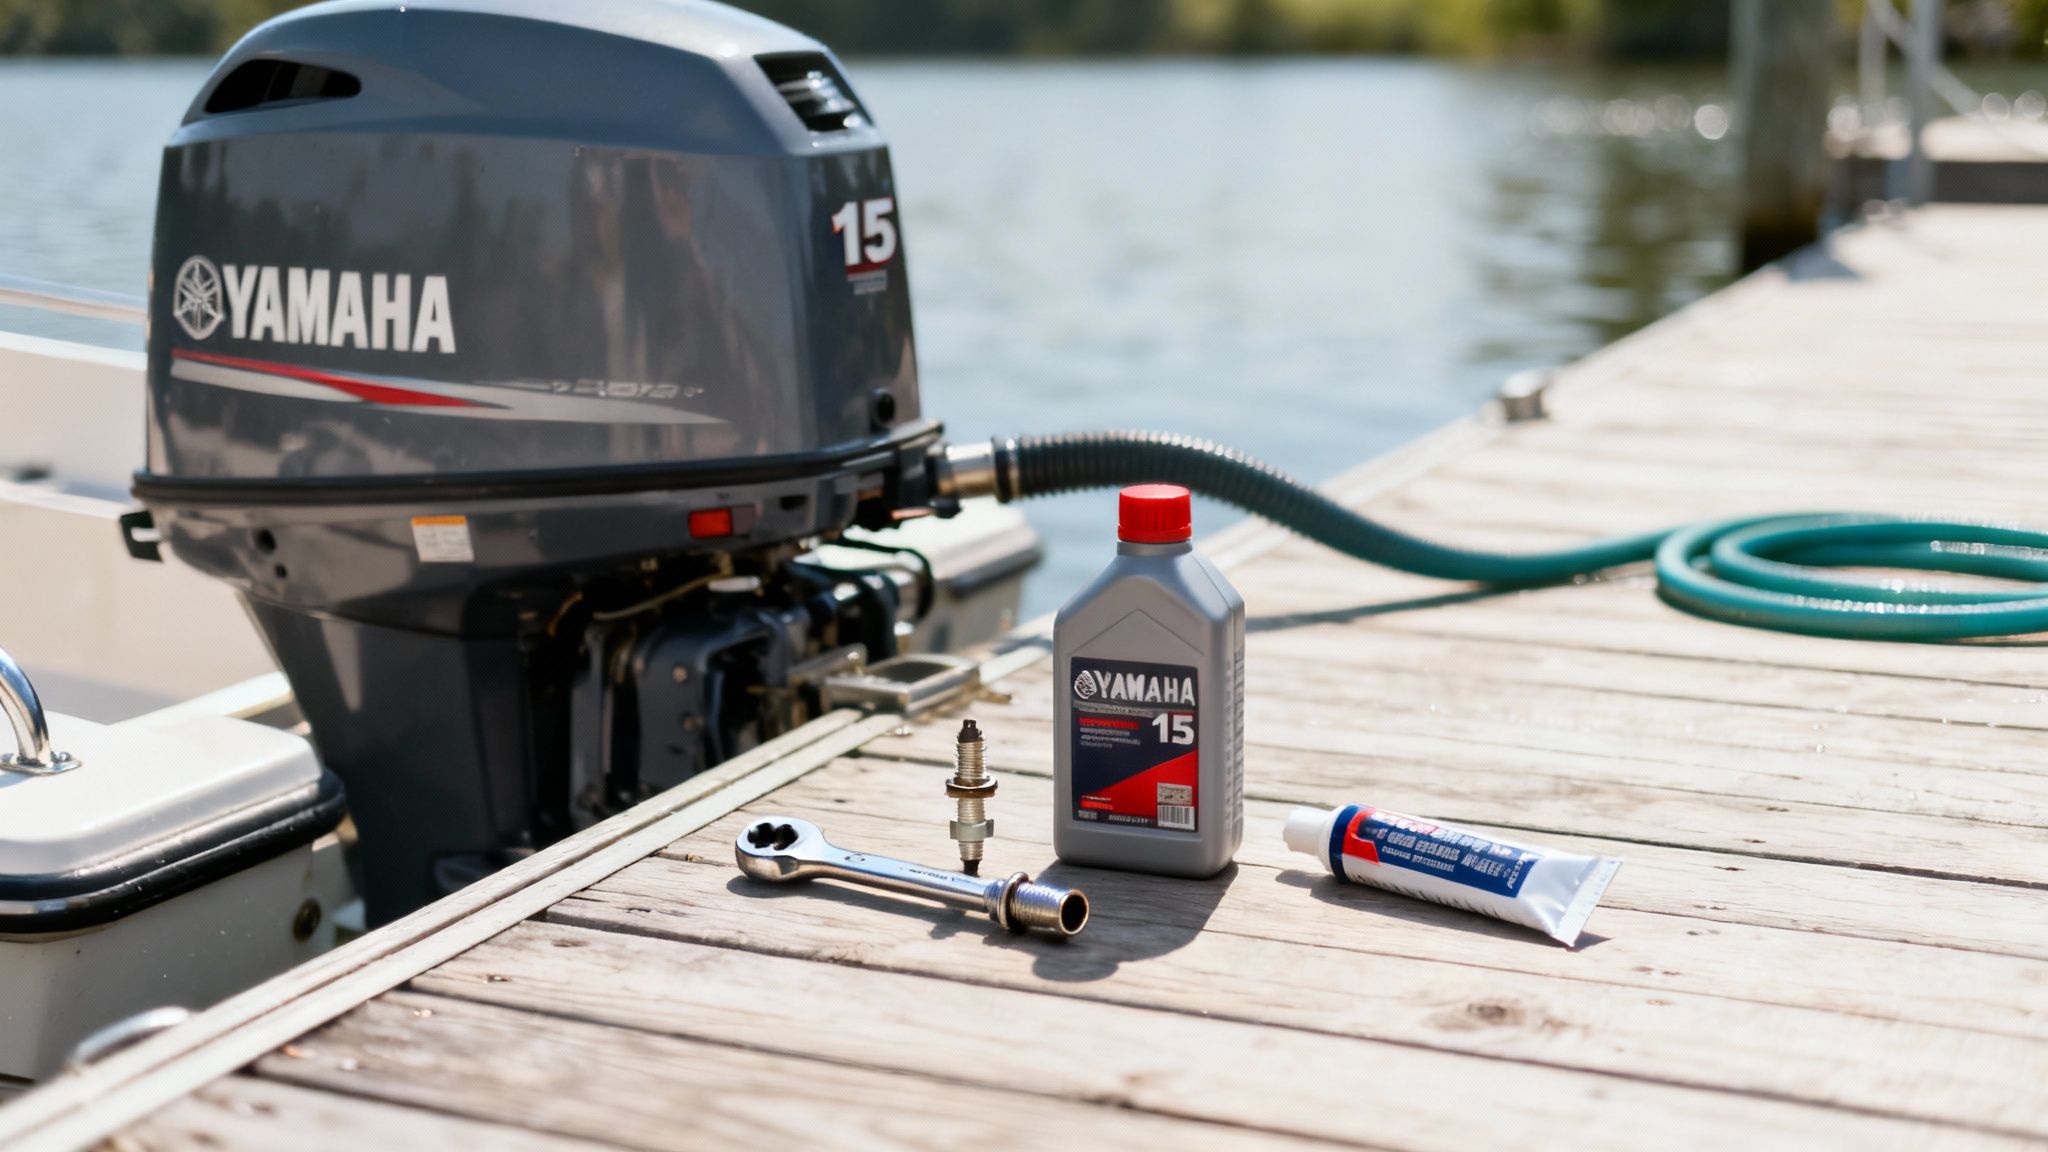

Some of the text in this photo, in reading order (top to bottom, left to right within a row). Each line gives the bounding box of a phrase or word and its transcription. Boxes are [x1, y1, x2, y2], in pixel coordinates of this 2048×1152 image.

[831, 197, 898, 266] 15
[222, 264, 456, 354] YAMAHA
[1093, 669, 1196, 706] YAMAHA
[1151, 712, 1195, 746] 15
